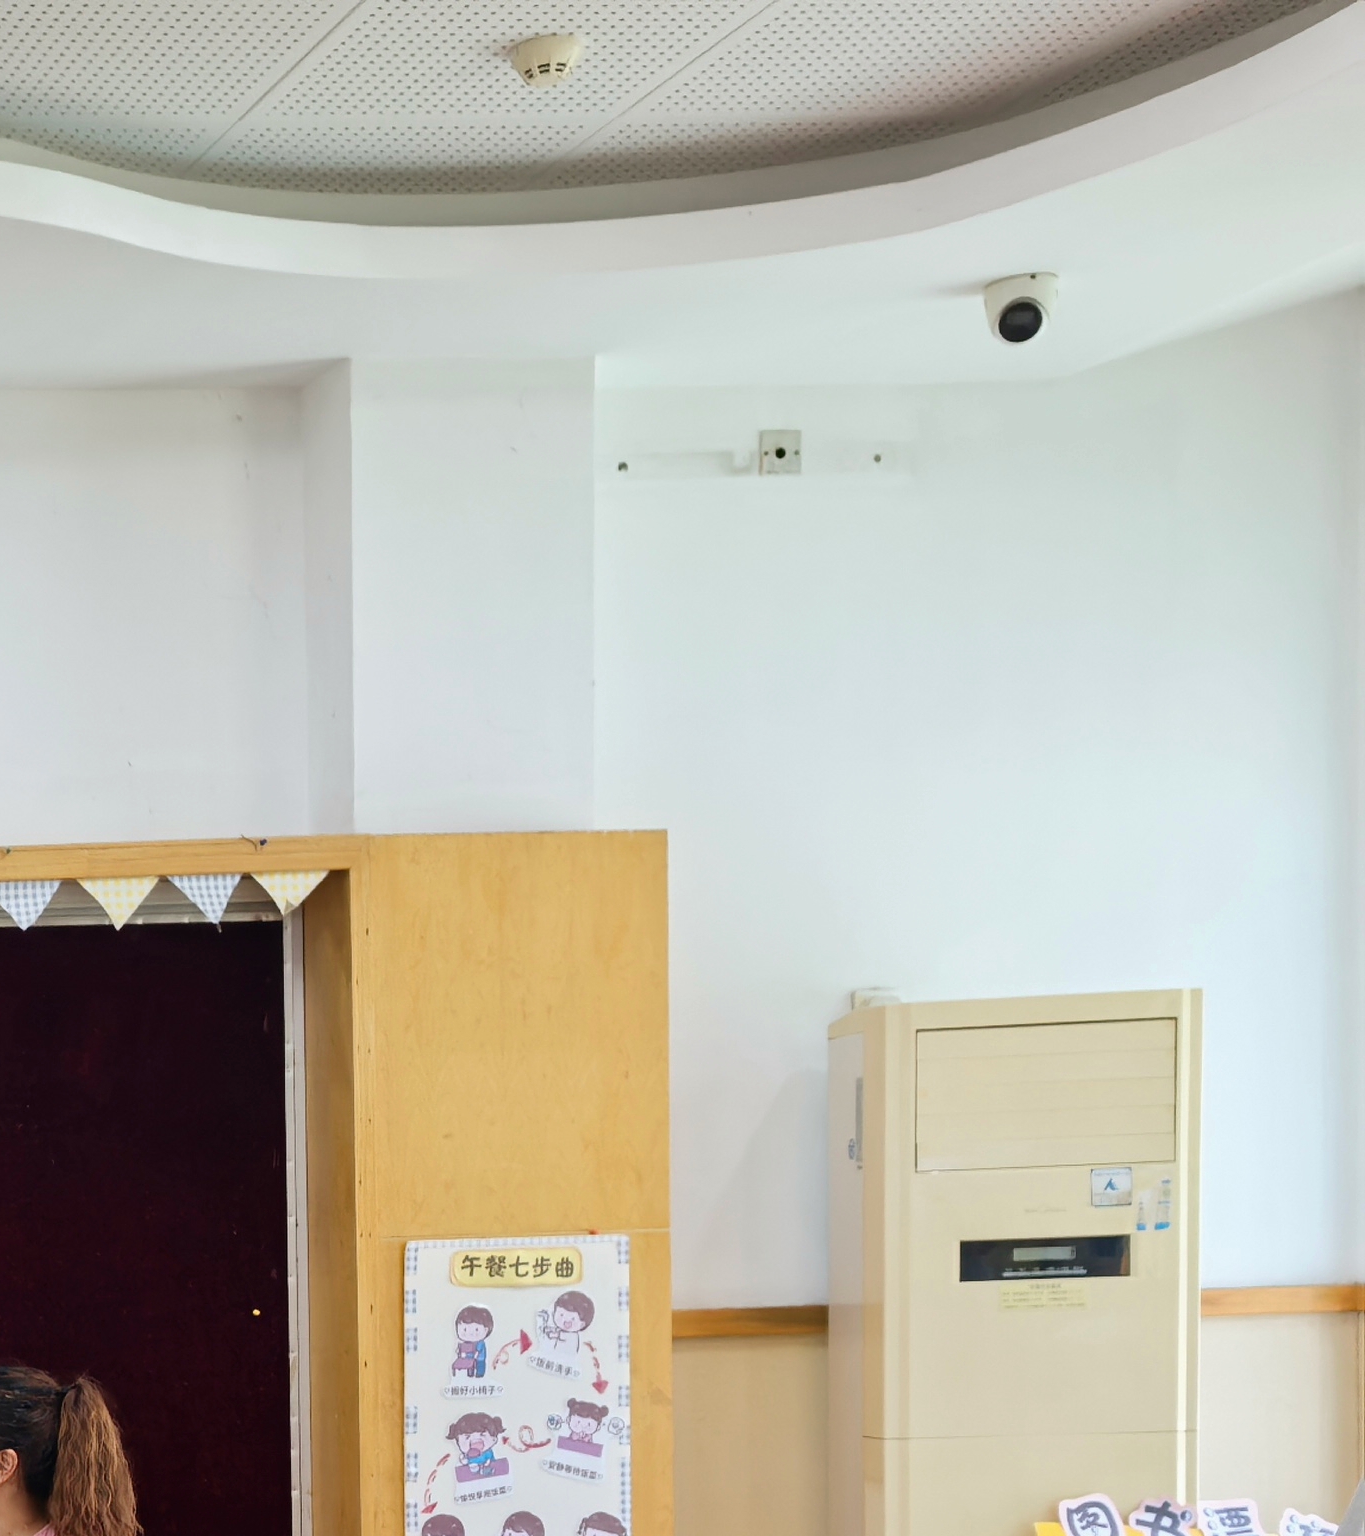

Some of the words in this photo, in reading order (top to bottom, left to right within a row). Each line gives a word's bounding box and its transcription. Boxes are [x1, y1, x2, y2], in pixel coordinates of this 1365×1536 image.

[460, 1254, 575, 1279] 午餐七步曲
